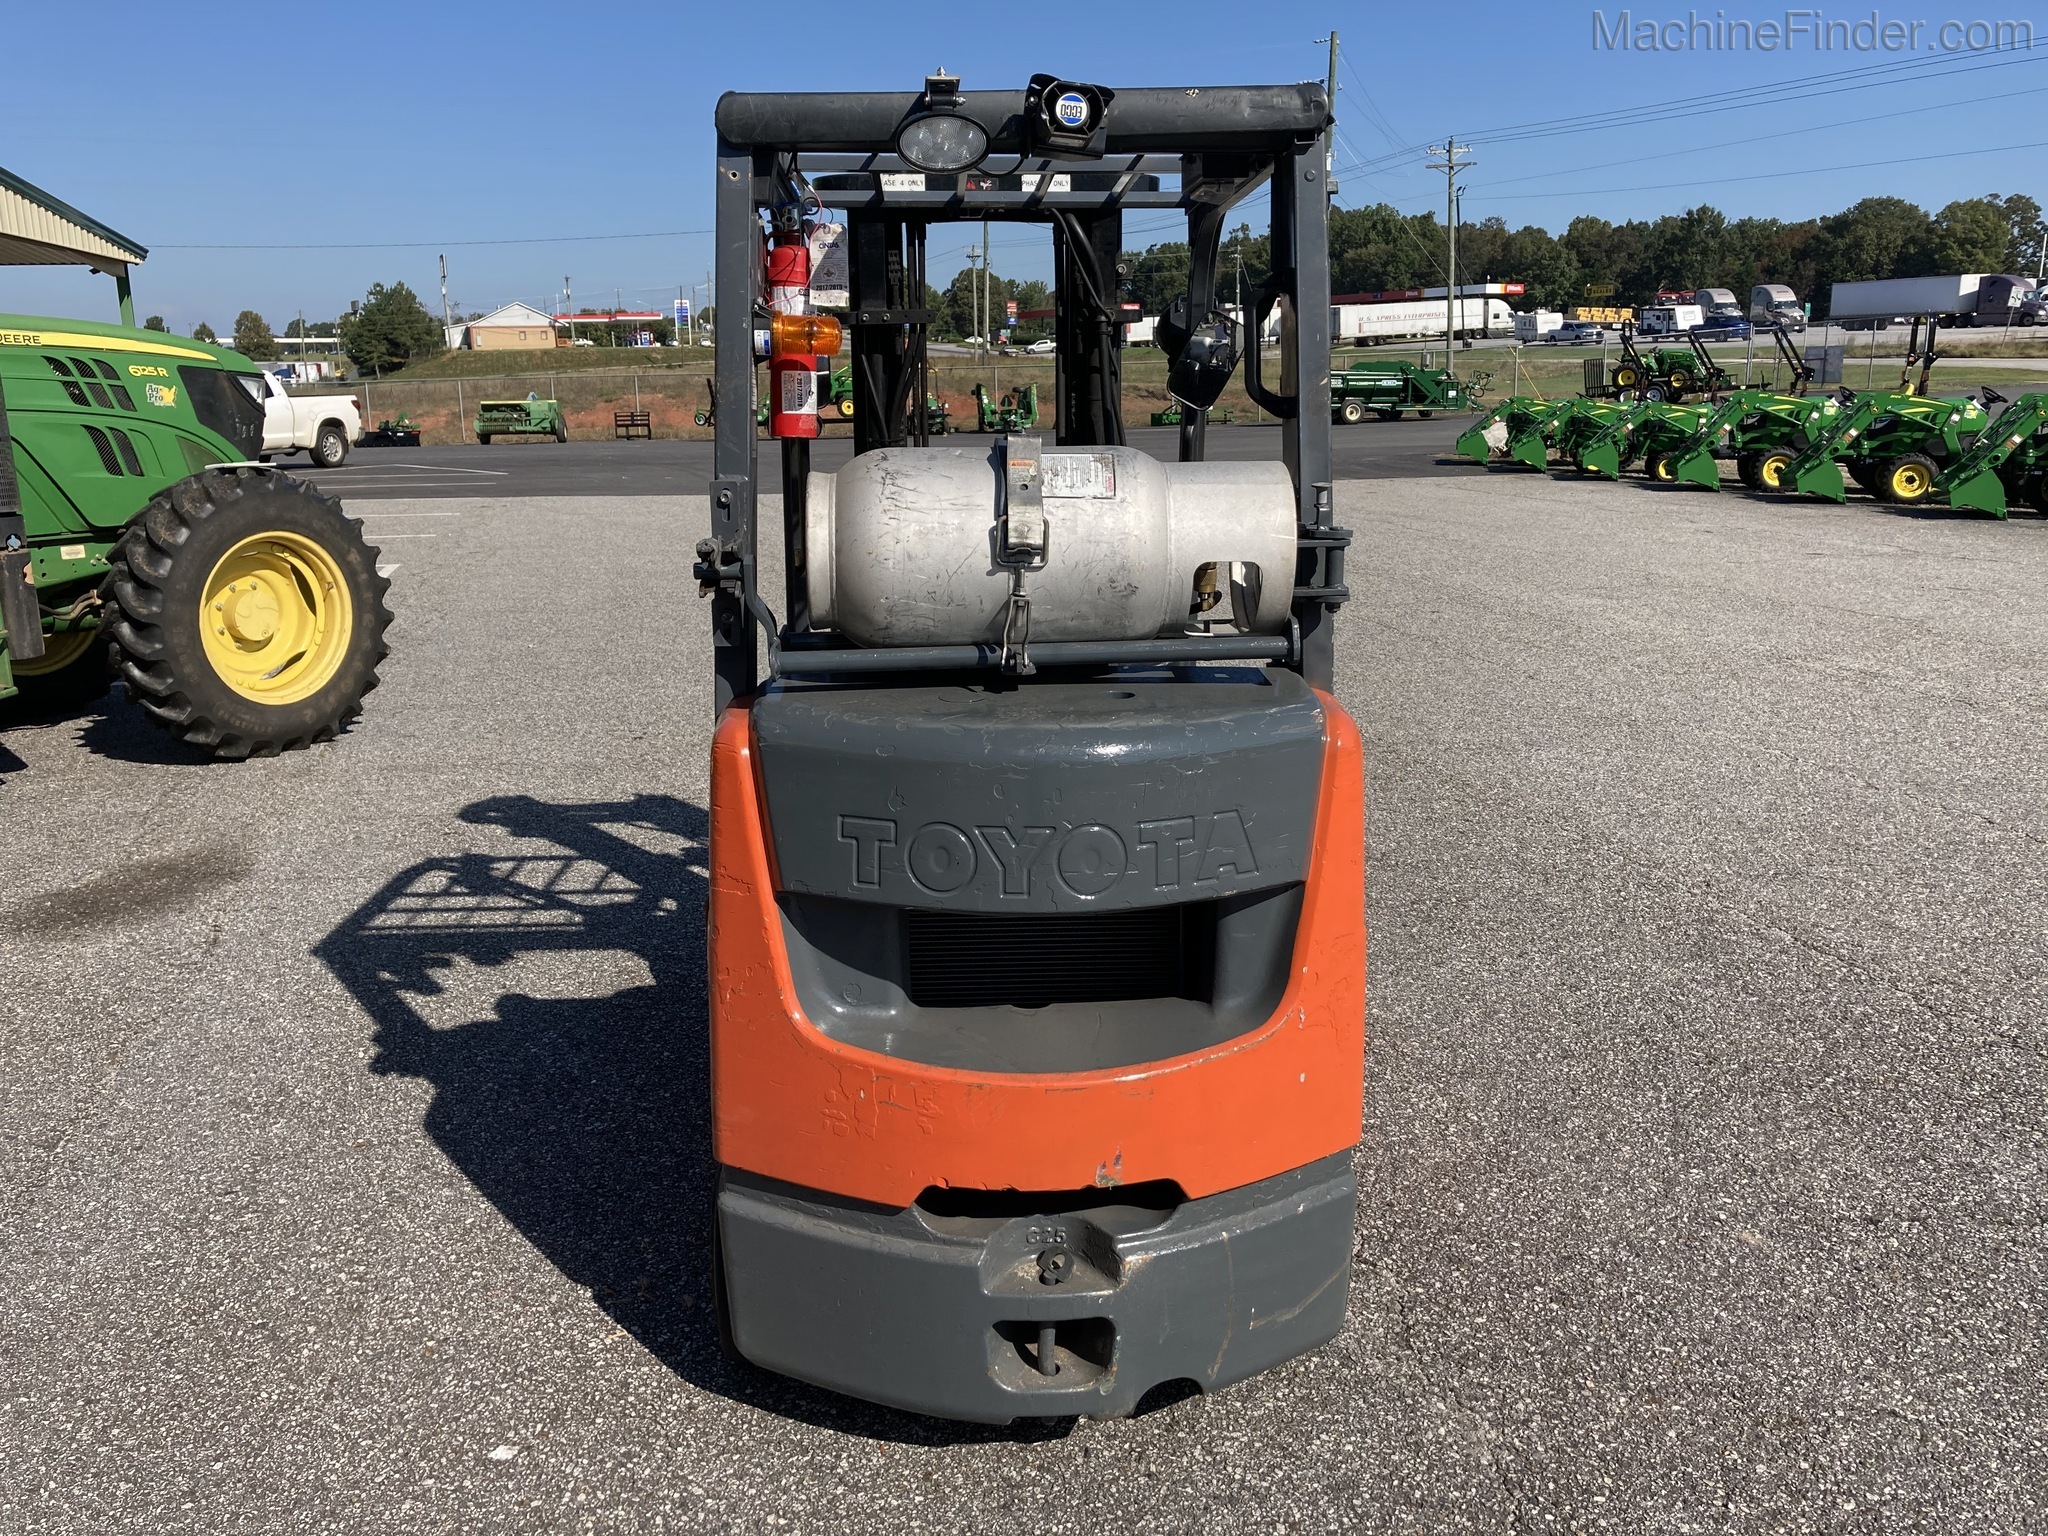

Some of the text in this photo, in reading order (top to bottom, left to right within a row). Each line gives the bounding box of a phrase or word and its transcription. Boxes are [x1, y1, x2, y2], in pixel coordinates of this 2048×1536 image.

[1060, 103, 1083, 118] ECCO
[900, 179, 904, 187] 4
[907, 179, 924, 187] ONLY
[0, 333, 41, 344] EERE
[148, 393, 164, 401] Pro
[836, 808, 1260, 899] TOYOTA
